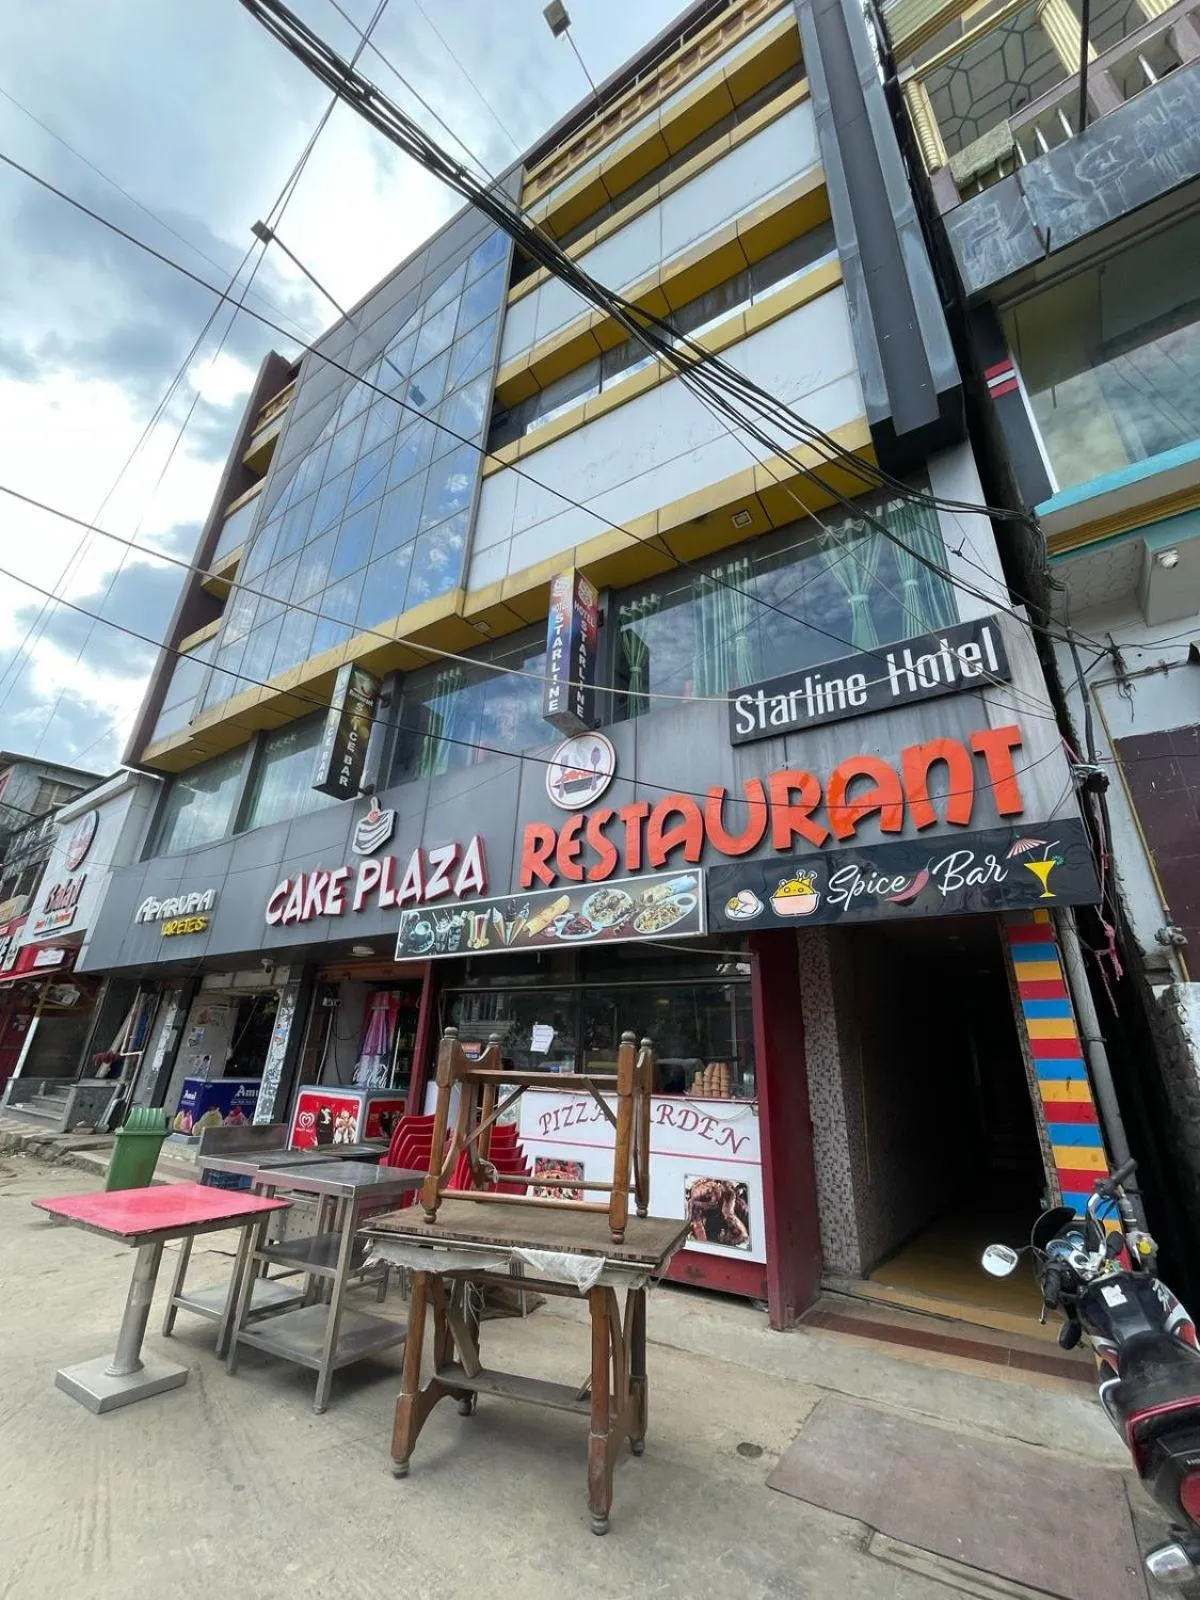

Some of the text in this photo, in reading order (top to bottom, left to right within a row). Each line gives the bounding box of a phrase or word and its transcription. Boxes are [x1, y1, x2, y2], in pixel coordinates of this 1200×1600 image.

[548, 611, 564, 712] STARLINE
[576, 619, 588, 719] STARLINE
[734, 626, 999, 734] Starline Hotel
[339, 754, 353, 787] BAR
[518, 724, 1024, 888] RESTAURANT
[134, 888, 217, 924] APARUPA
[265, 834, 488, 926] CAKE PLAZA
[826, 849, 1008, 911] Spice Bar
